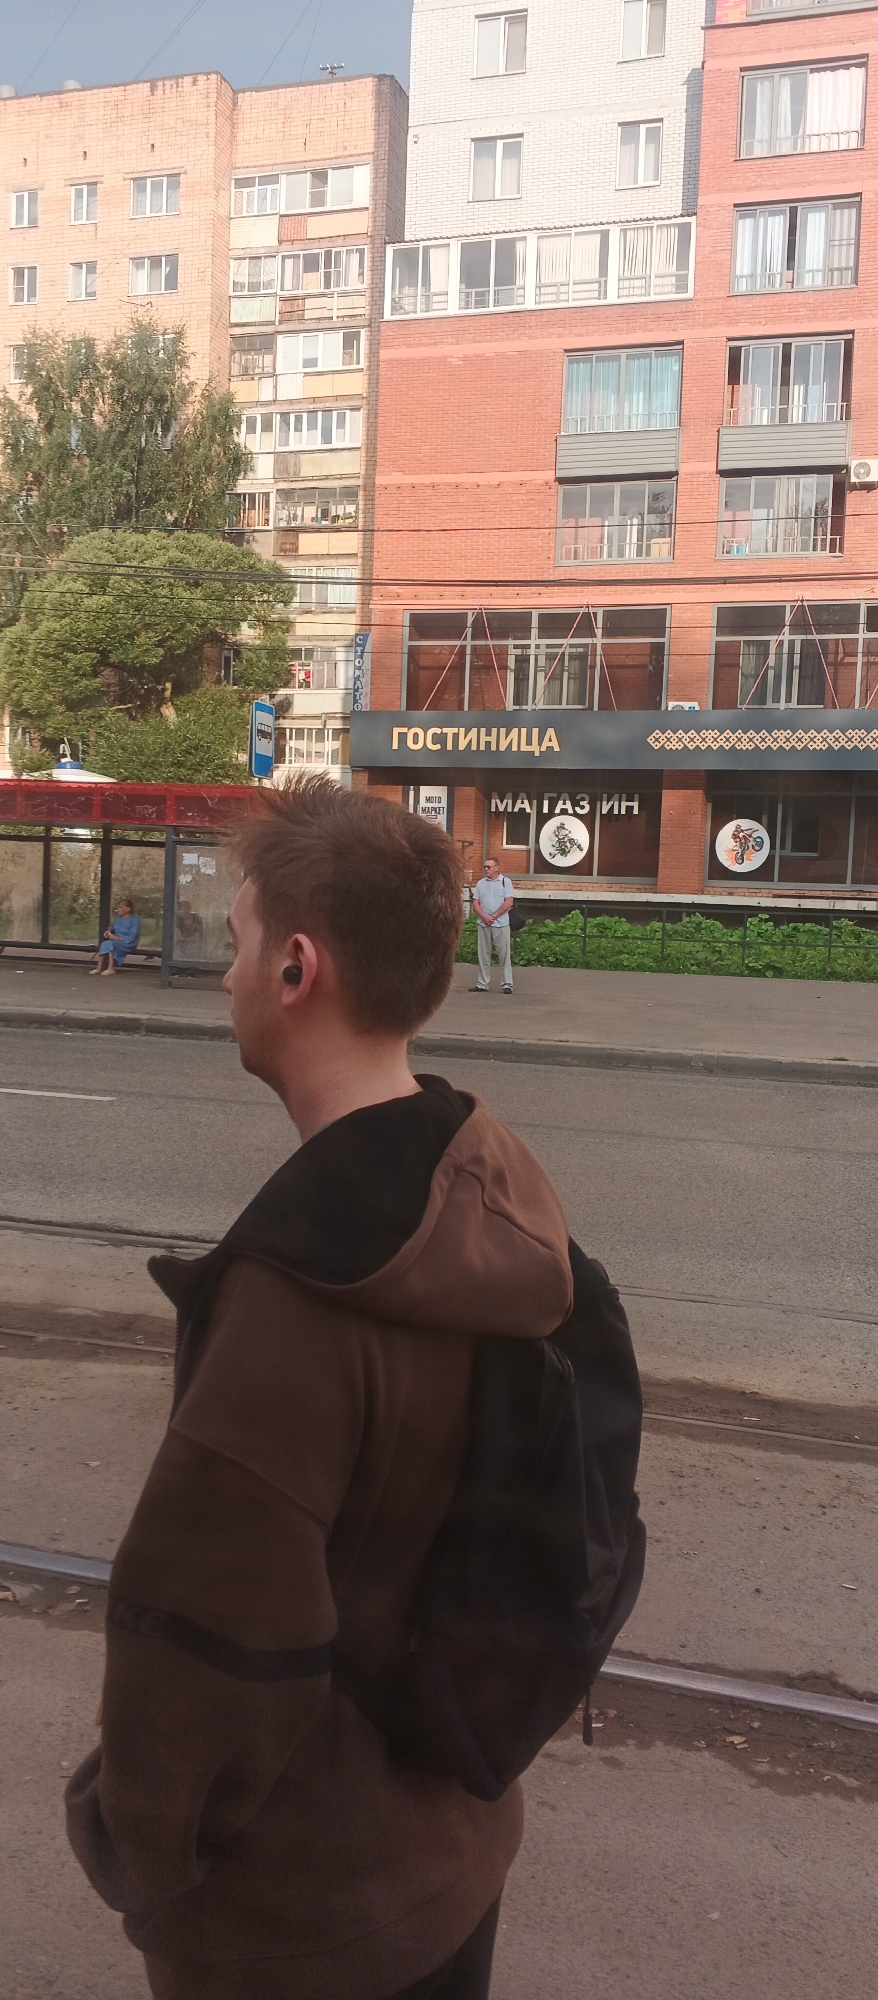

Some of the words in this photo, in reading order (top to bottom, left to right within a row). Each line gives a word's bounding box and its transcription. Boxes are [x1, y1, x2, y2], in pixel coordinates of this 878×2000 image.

[391, 727, 561, 757] ГОСТИНИЦА
[425, 796, 442, 804] МОТО
[421, 806, 445, 815] МАРКЕТ
